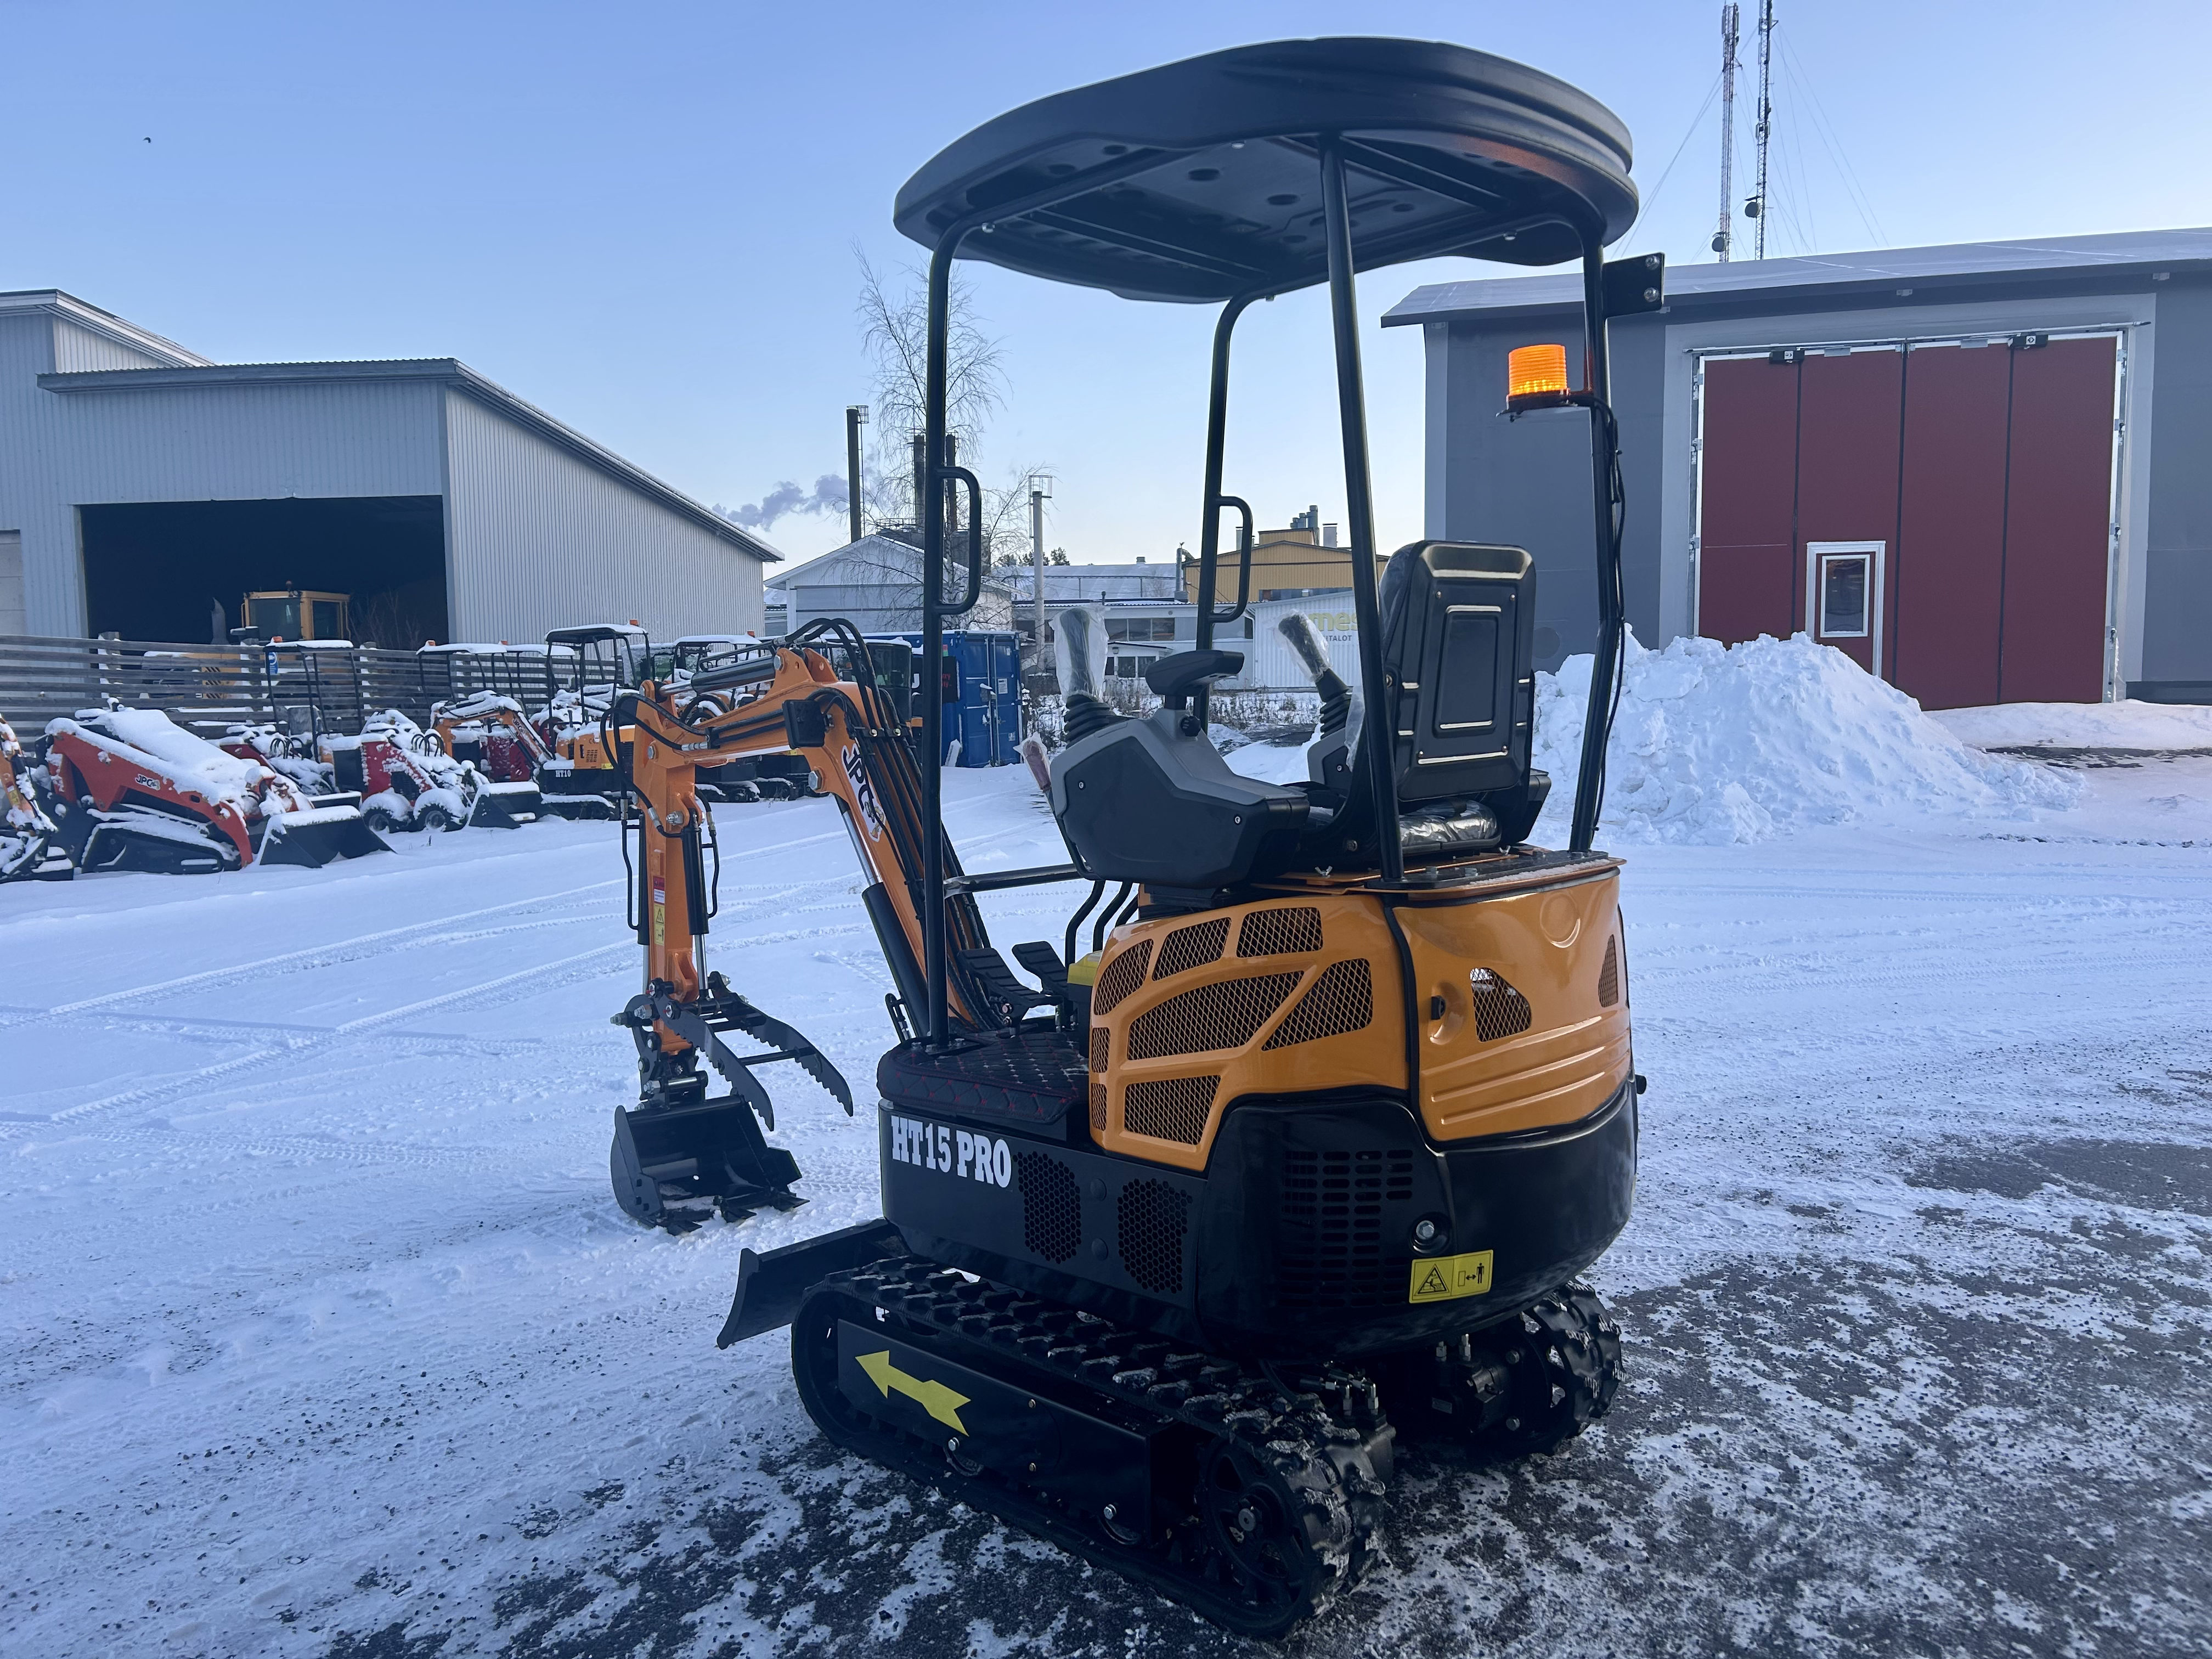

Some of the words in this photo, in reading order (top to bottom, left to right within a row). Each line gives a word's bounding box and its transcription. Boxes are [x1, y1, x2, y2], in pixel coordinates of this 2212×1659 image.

[136, 775, 153, 787] JPC
[891, 1115, 951, 1173] HT15
[956, 1130, 1012, 1188] PRO
